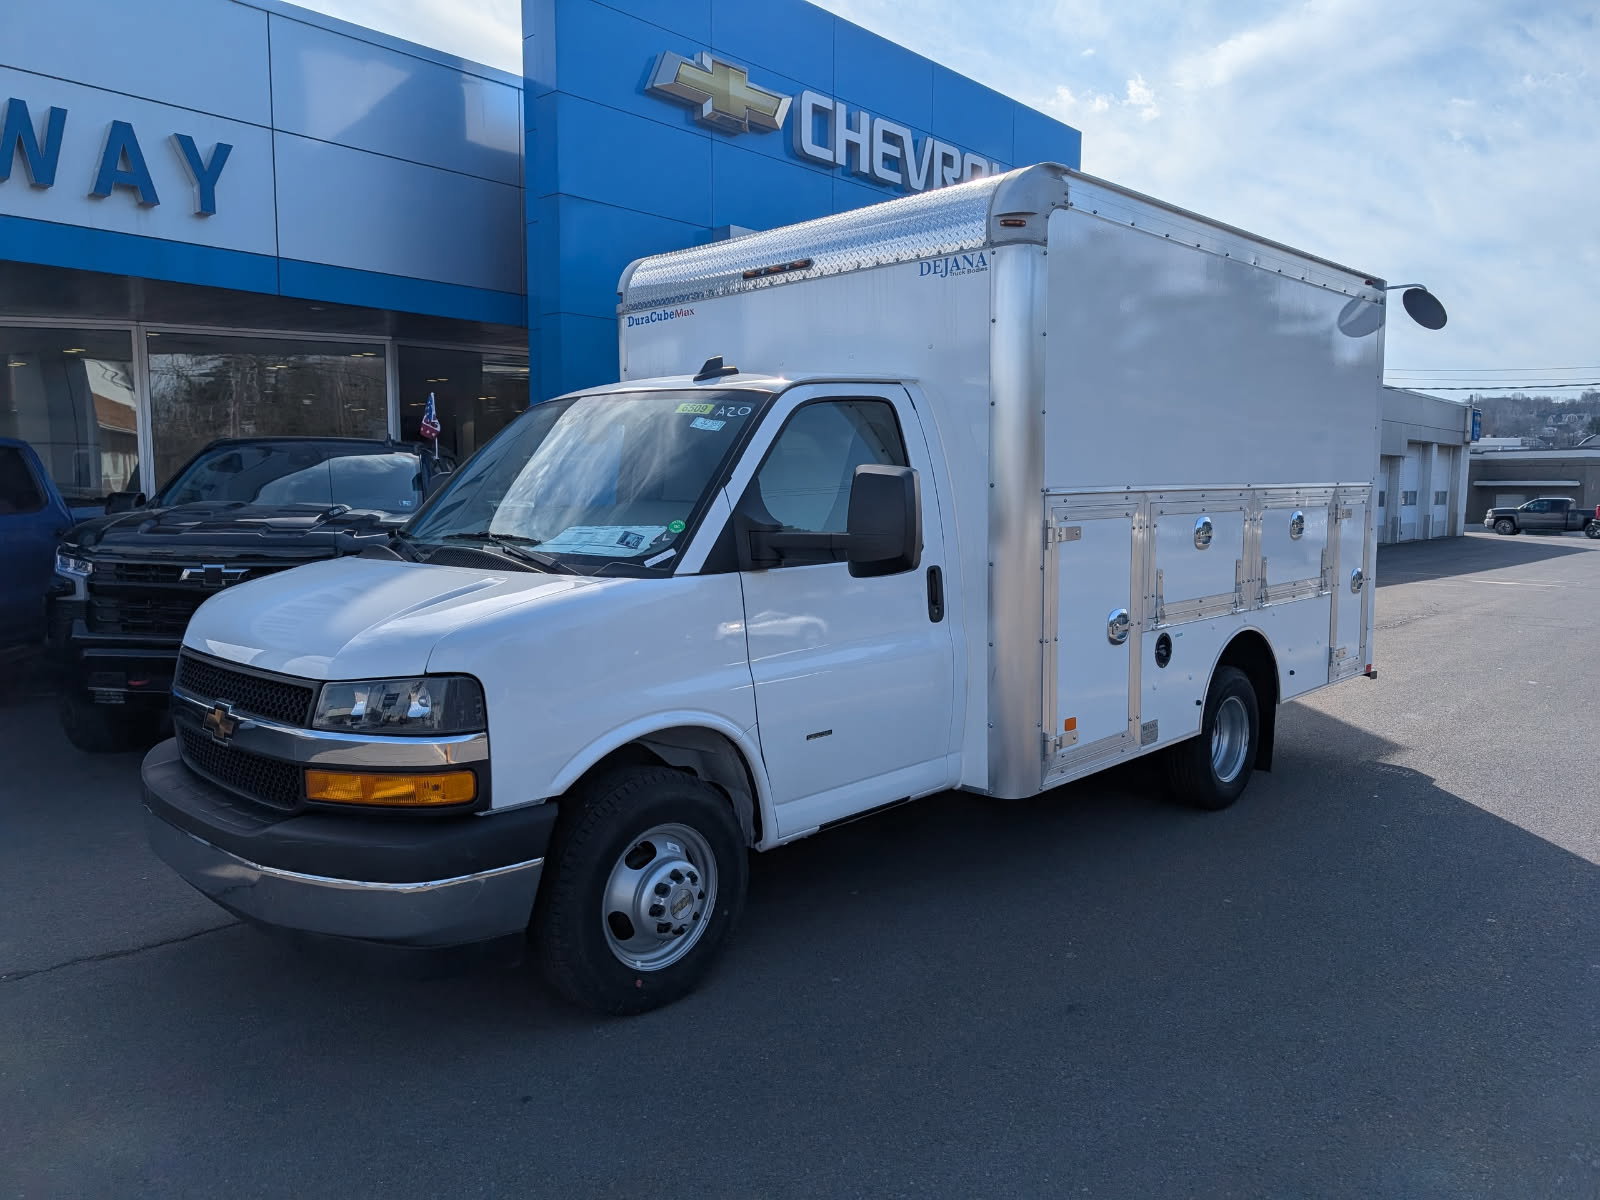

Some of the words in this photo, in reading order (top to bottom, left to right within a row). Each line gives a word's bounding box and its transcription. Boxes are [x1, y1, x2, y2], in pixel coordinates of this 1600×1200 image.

[797, 90, 1000, 191] CHEVRO
[919, 251, 987, 278] DEJANA
[949, 269, 966, 277] Truck
[627, 308, 695, 328] DuraCubeMax
